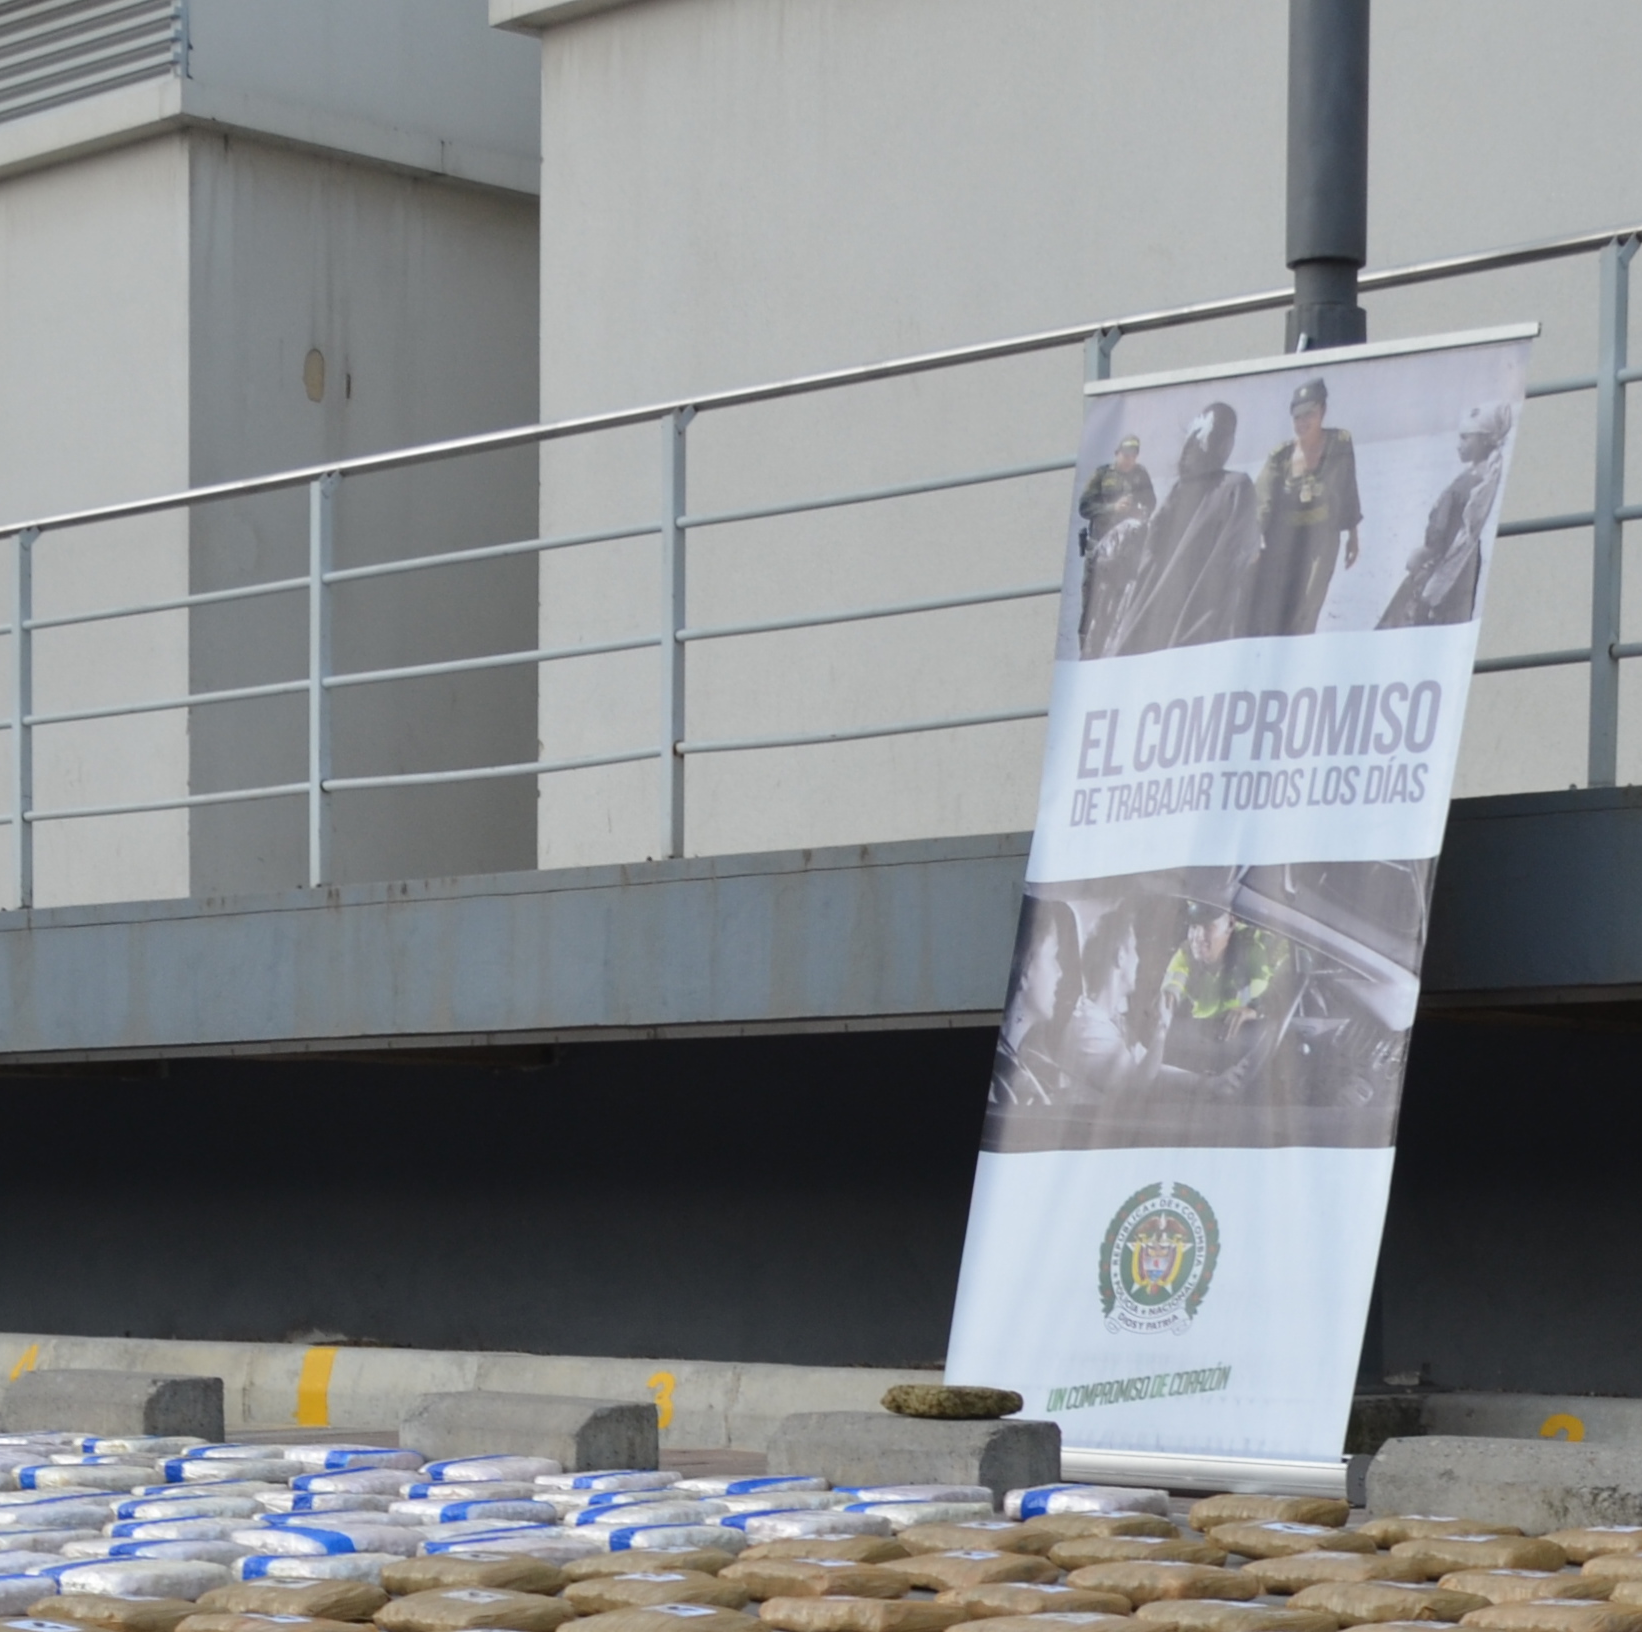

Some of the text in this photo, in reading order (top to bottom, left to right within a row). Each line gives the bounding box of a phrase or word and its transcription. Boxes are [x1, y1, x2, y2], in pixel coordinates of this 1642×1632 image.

[1077, 680, 1442, 779] EL COMPROMISO
[1070, 755, 1429, 827] DE TRABAJAR TODOS LOS DÍAS
[1159, 1199, 1173, 1208] DE
[1181, 1206, 1205, 1267] COLOMBIA
[1146, 1313, 1179, 1331] PATRIA
[1148, 1282, 1195, 1316] NACIONAL
[647, 1371, 676, 1430] 3
[1046, 1361, 1232, 1413] UN COMPROMISO DE CORAZÓN
